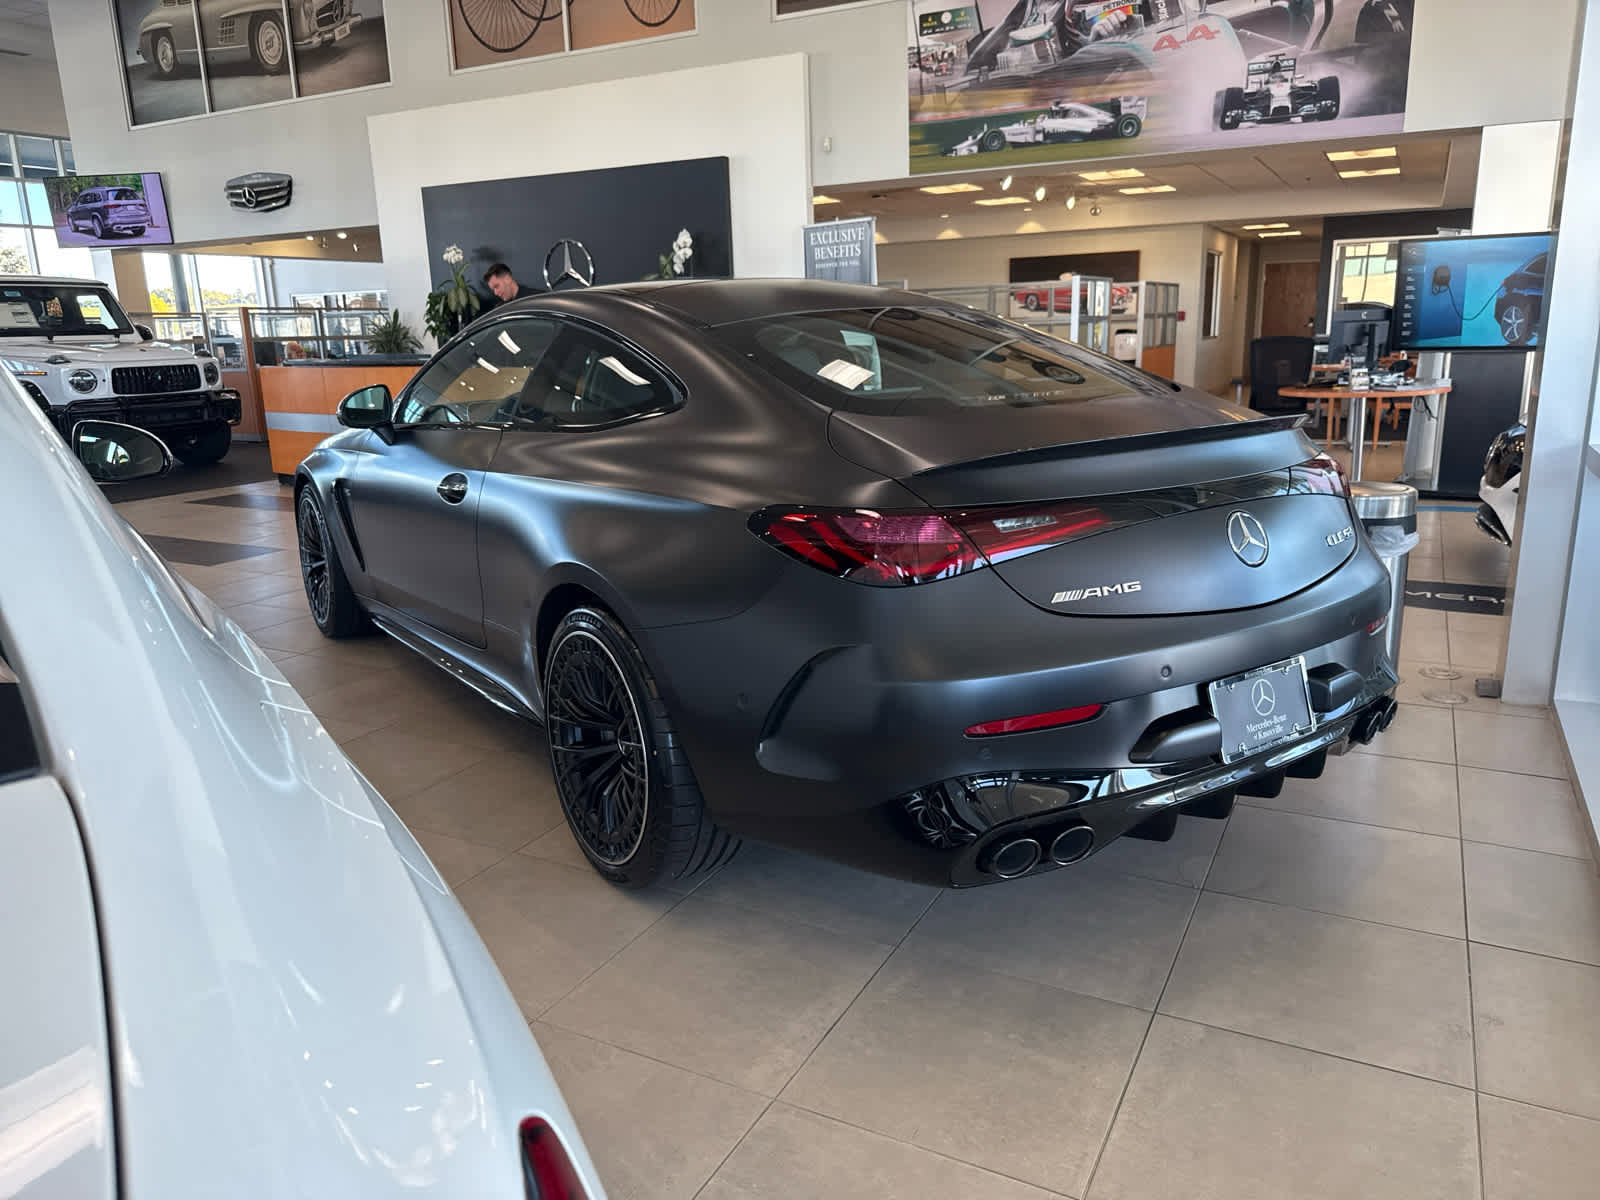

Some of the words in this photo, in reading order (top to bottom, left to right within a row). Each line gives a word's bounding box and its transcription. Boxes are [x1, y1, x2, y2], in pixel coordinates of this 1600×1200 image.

[810, 227, 864, 245] EXCLUSIVE
[814, 244, 861, 260] BENEFITS
[1080, 580, 1142, 600] AMG
